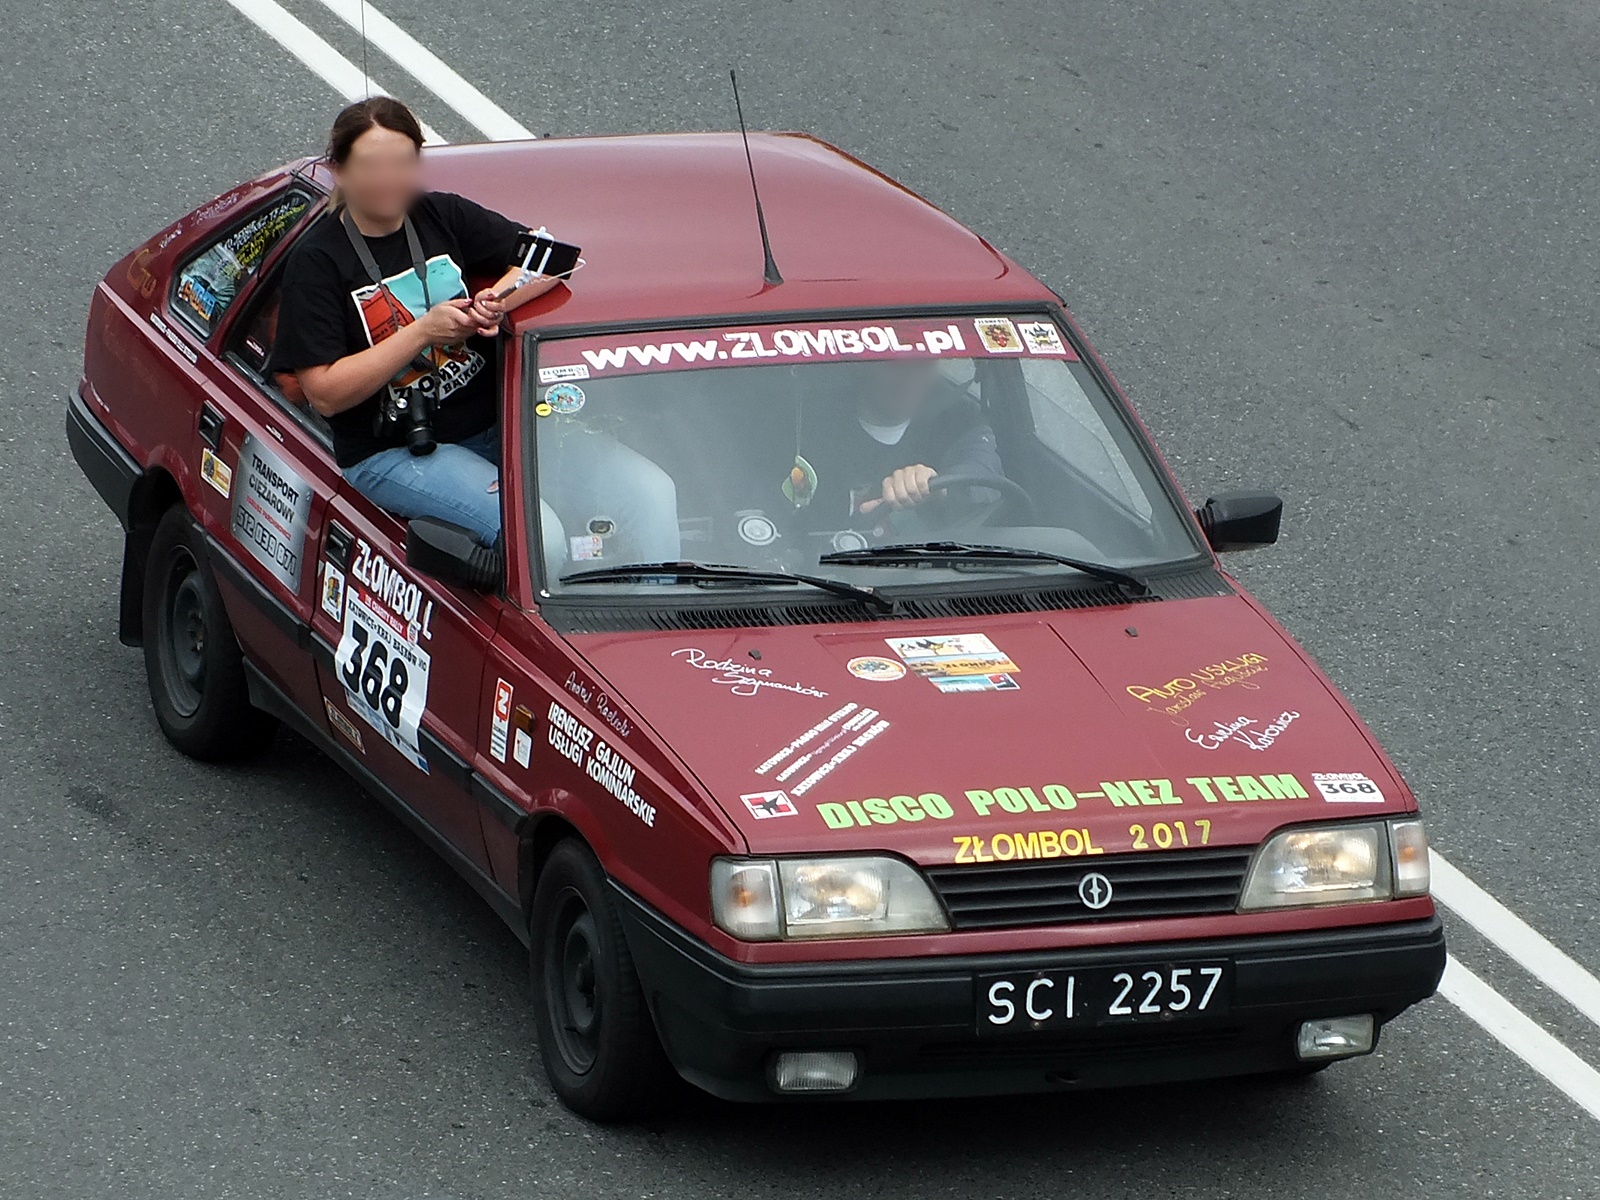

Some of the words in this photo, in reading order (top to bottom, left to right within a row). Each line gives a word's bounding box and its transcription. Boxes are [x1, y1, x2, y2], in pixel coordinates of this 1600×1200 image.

[248, 473, 296, 523] CIĘŻAROWY
[252, 453, 300, 506] TRANSPORT
[236, 504, 256, 539] 512
[254, 521, 278, 558] 039
[342, 619, 409, 729] 368
[671, 648, 773, 678] Rodzina
[547, 701, 594, 752] IRENEUSZ
[548, 725, 583, 768] USŁUGI
[585, 756, 657, 828] KOMINIARSKIE
[816, 793, 955, 830] DISCO
[1186, 773, 1309, 803] TEAM
[1320, 782, 1376, 794] 368
[952, 828, 1104, 865] ZŁOMBOL
[1129, 819, 1212, 850] 2017
[987, 974, 1076, 1025] SCI
[1108, 966, 1224, 1016] 2257
